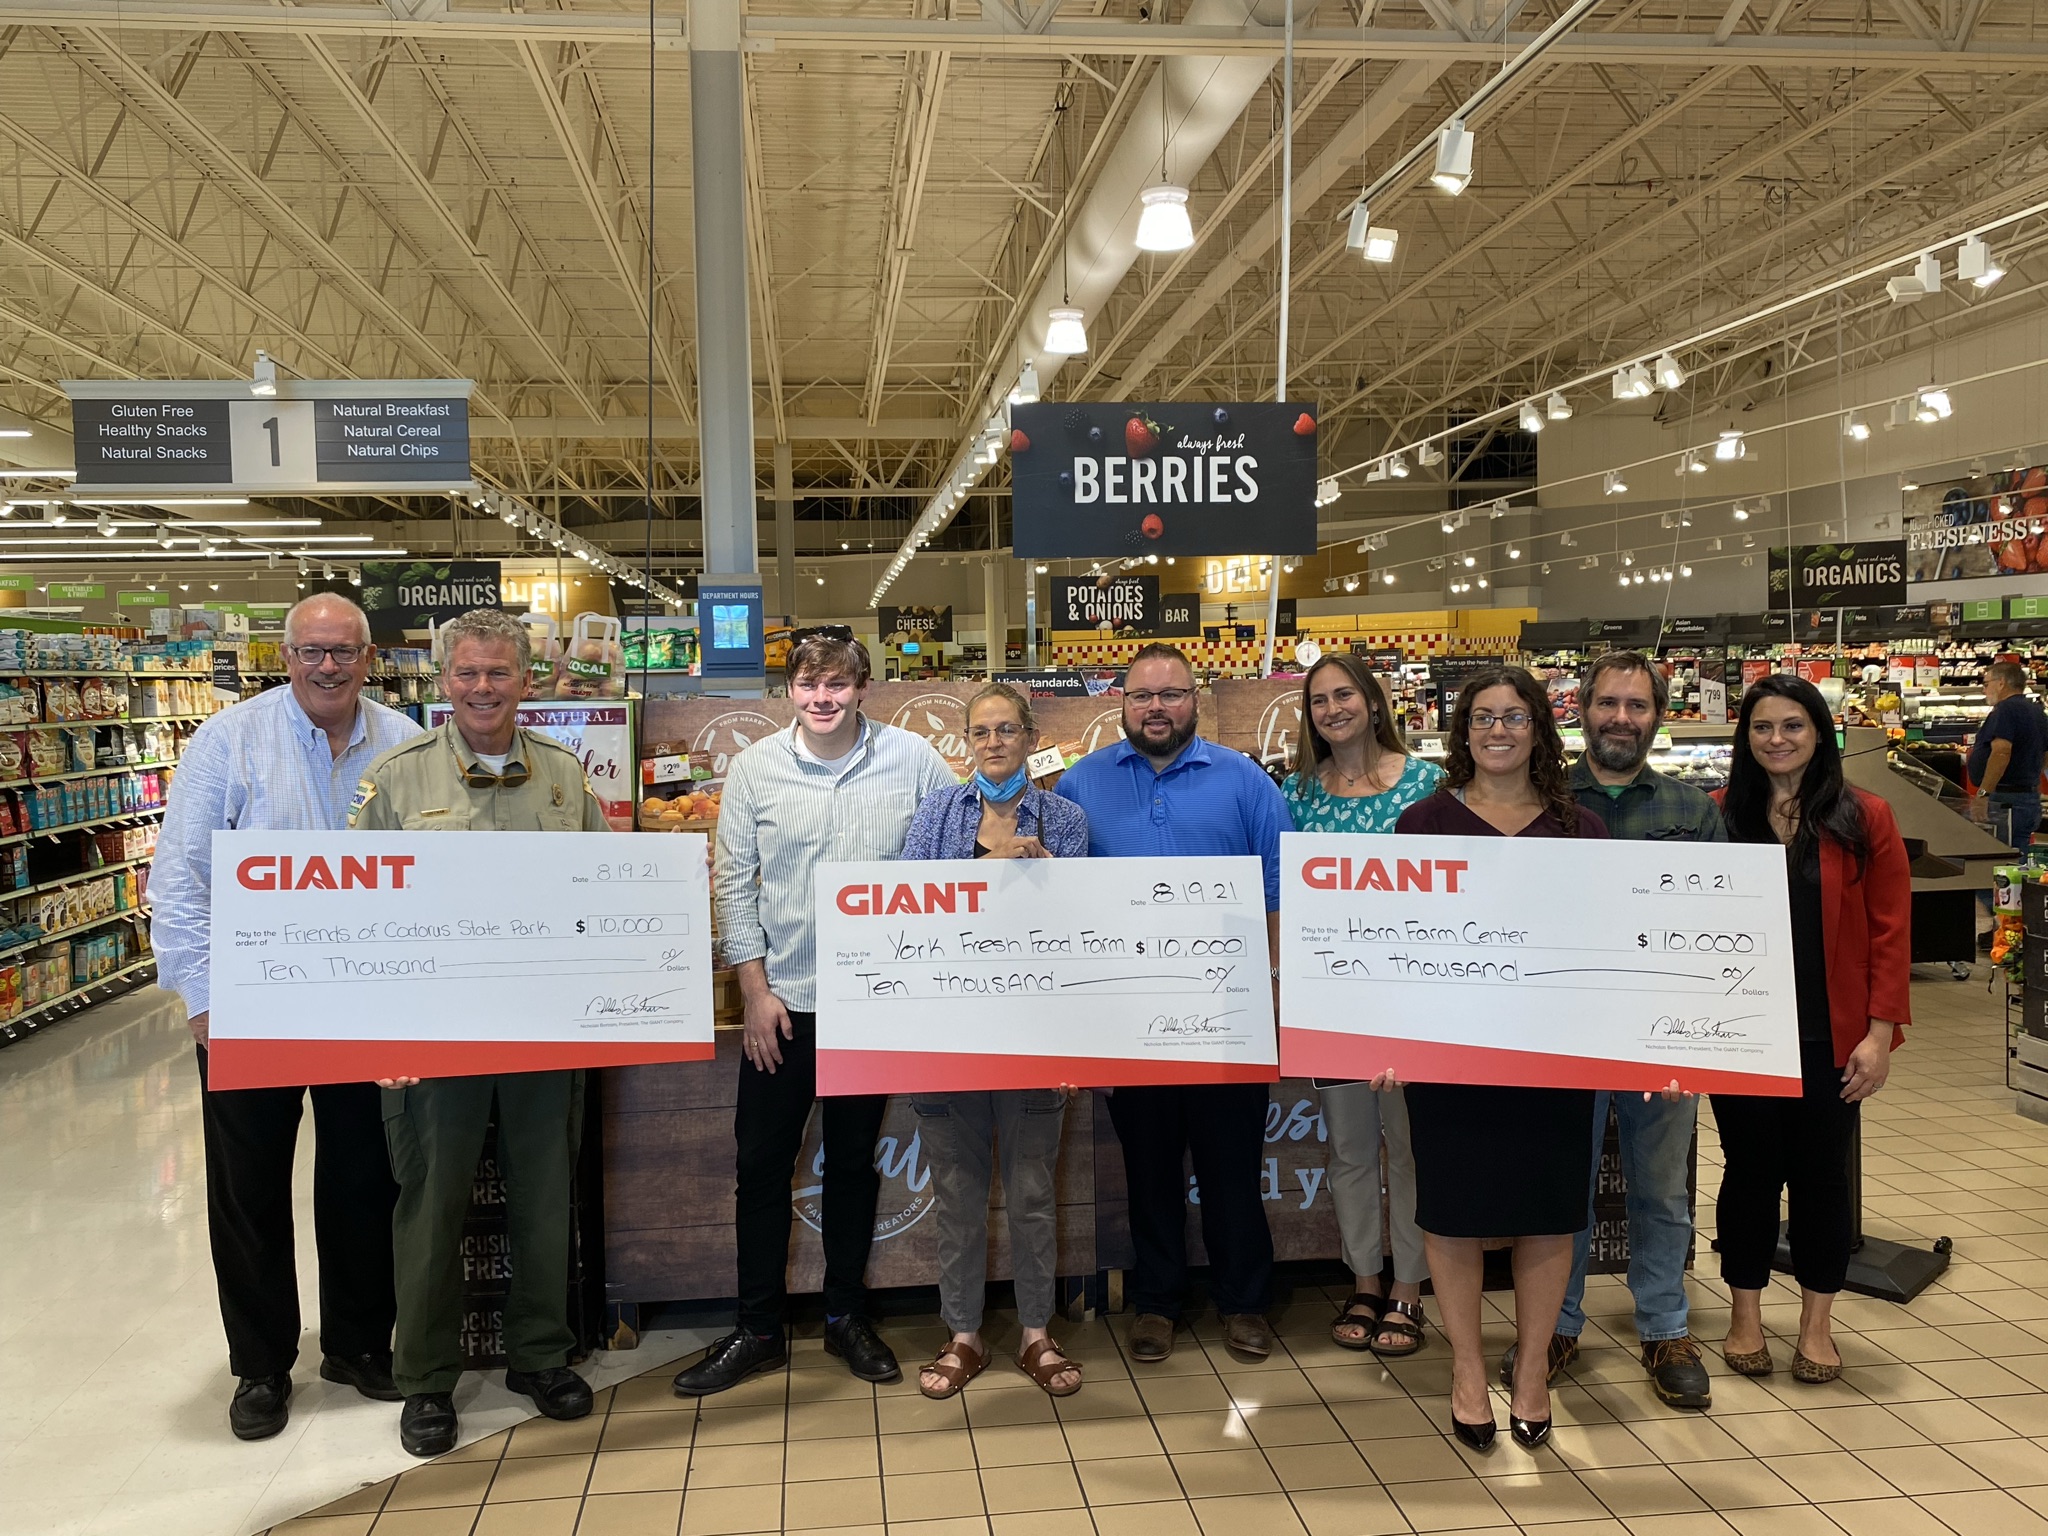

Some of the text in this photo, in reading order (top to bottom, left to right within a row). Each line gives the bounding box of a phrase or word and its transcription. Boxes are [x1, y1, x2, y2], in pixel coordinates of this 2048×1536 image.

[111, 404, 194, 418] Gluten Free
[333, 404, 450, 417] Natural Breakfast
[99, 424, 208, 438] Healthy Snacks
[344, 424, 441, 437] Natural Cereal
[262, 417, 281, 467] 1
[1177, 433, 1245, 456] always fresh
[101, 446, 208, 460] Natural Snacks
[347, 444, 439, 460] Natural Chips
[1074, 455, 1259, 504] BERRIES
[1206, 555, 1267, 594] DELI
[1802, 562, 1901, 587] ORGANICS
[398, 584, 497, 606] ORGANICS
[500, 582, 568, 613] HEN
[1067, 585, 1144, 604] POTATOES
[1068, 603, 1144, 621] & ONIONS
[1165, 608, 1190, 622] BAR
[234, 614, 240, 627] 3
[896, 618, 935, 630] CHEESE
[568, 660, 608, 676] LOCAL
[1026, 678, 1082, 688] standards.
[1030, 690, 1056, 698] rices.
[1282, 695, 1299, 706] FROM
[914, 700, 960, 710] FROM NEARBY
[535, 710, 614, 722] NATURAL
[719, 716, 767, 728] FROM NEARBY
[1104, 713, 1122, 724] FROM
[236, 856, 416, 890] GIANT
[1301, 856, 1468, 893] GIANT
[836, 882, 988, 916] GIANT
[284, 919, 550, 943] Friends of Codorus State Park
[576, 919, 586, 934] $
[599, 918, 663, 934] 10,000
[1302, 926, 1316, 934] Pay
[1348, 918, 1528, 944] Horn Farm Center
[888, 930, 945, 960] York
[959, 932, 1022, 954] Fresh
[1028, 930, 1072, 954] Food
[1136, 941, 1146, 955] $
[1158, 938, 1243, 958] 10,000
[1637, 933, 1648, 948] $
[1664, 930, 1754, 952] 10,000
[258, 956, 436, 980] Ten Thousand
[1314, 950, 1370, 976] Ten
[855, 973, 910, 998] Ten
[1742, 988, 1770, 996] Dollars
[464, 1255, 513, 1281] FRES
